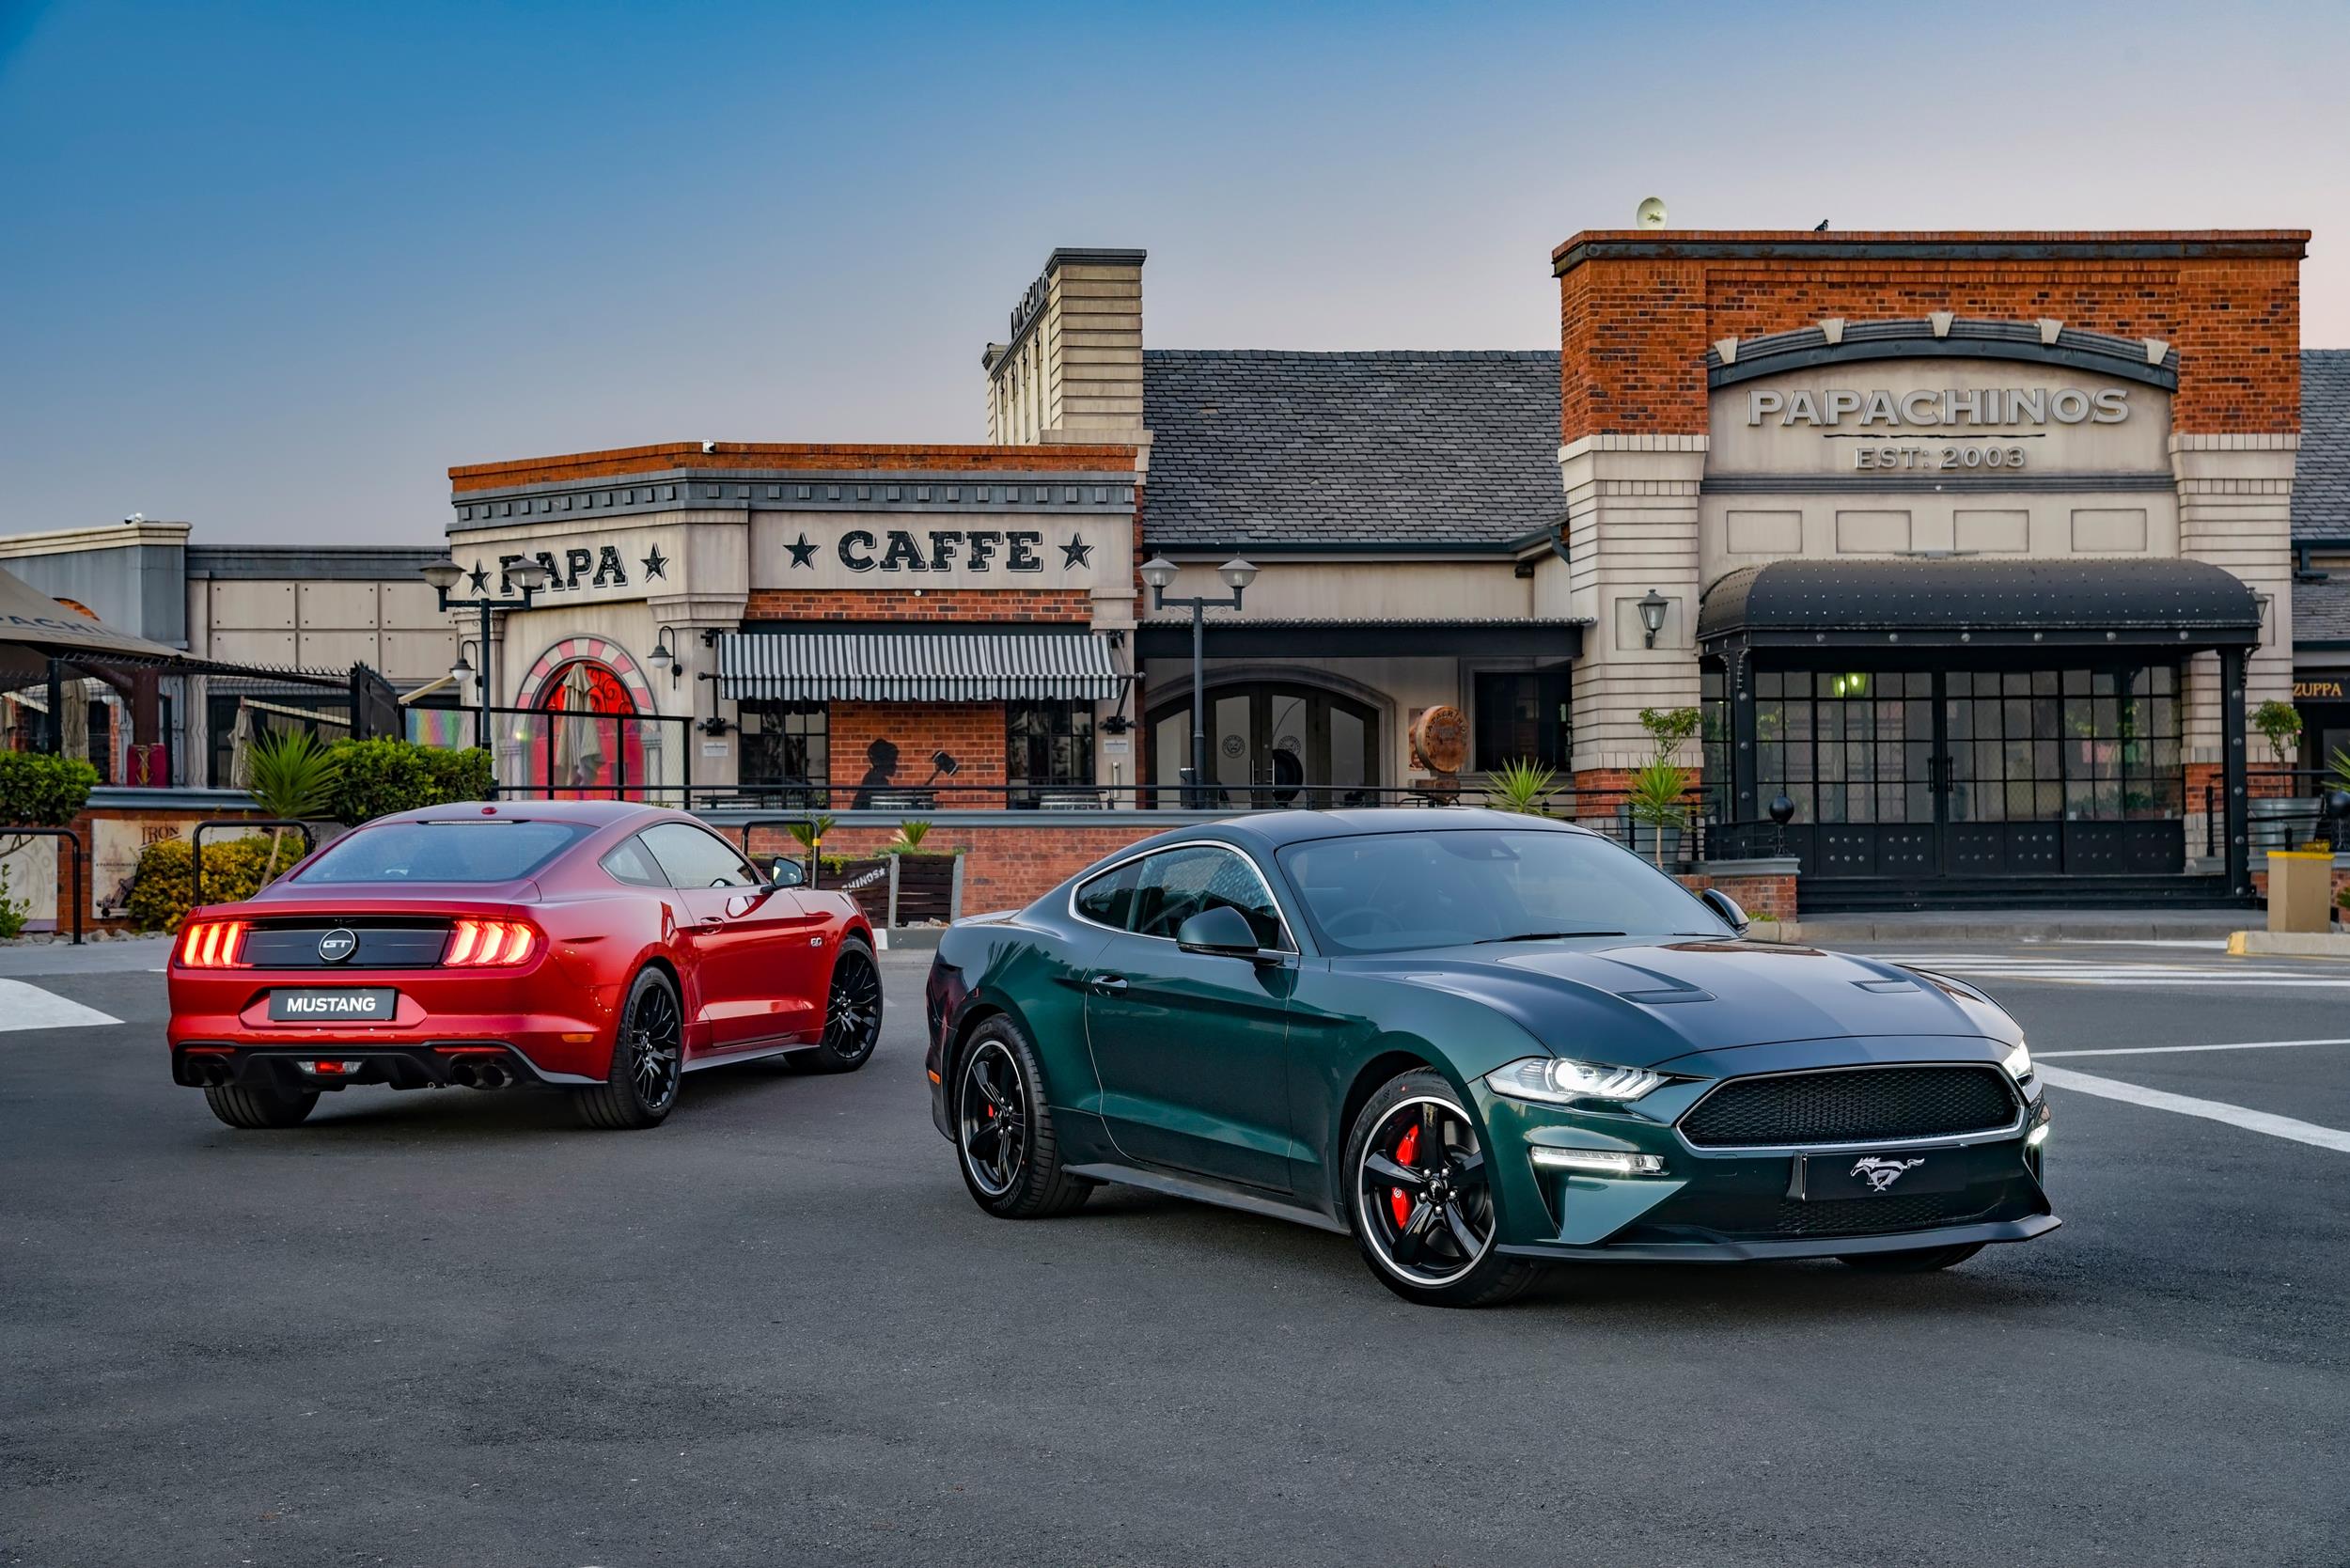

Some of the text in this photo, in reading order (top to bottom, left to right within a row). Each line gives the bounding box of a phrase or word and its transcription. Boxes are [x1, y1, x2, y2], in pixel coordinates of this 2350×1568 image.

[1747, 387, 2130, 427] PAPACHINOS
[1856, 446, 2026, 470] EST: 2003
[838, 529, 1043, 573] CAFFE
[2292, 682, 2342, 697] ZUPPA
[141, 826, 180, 845] IRON
[322, 939, 352, 949] GT
[286, 996, 376, 1012] MUSTANG
